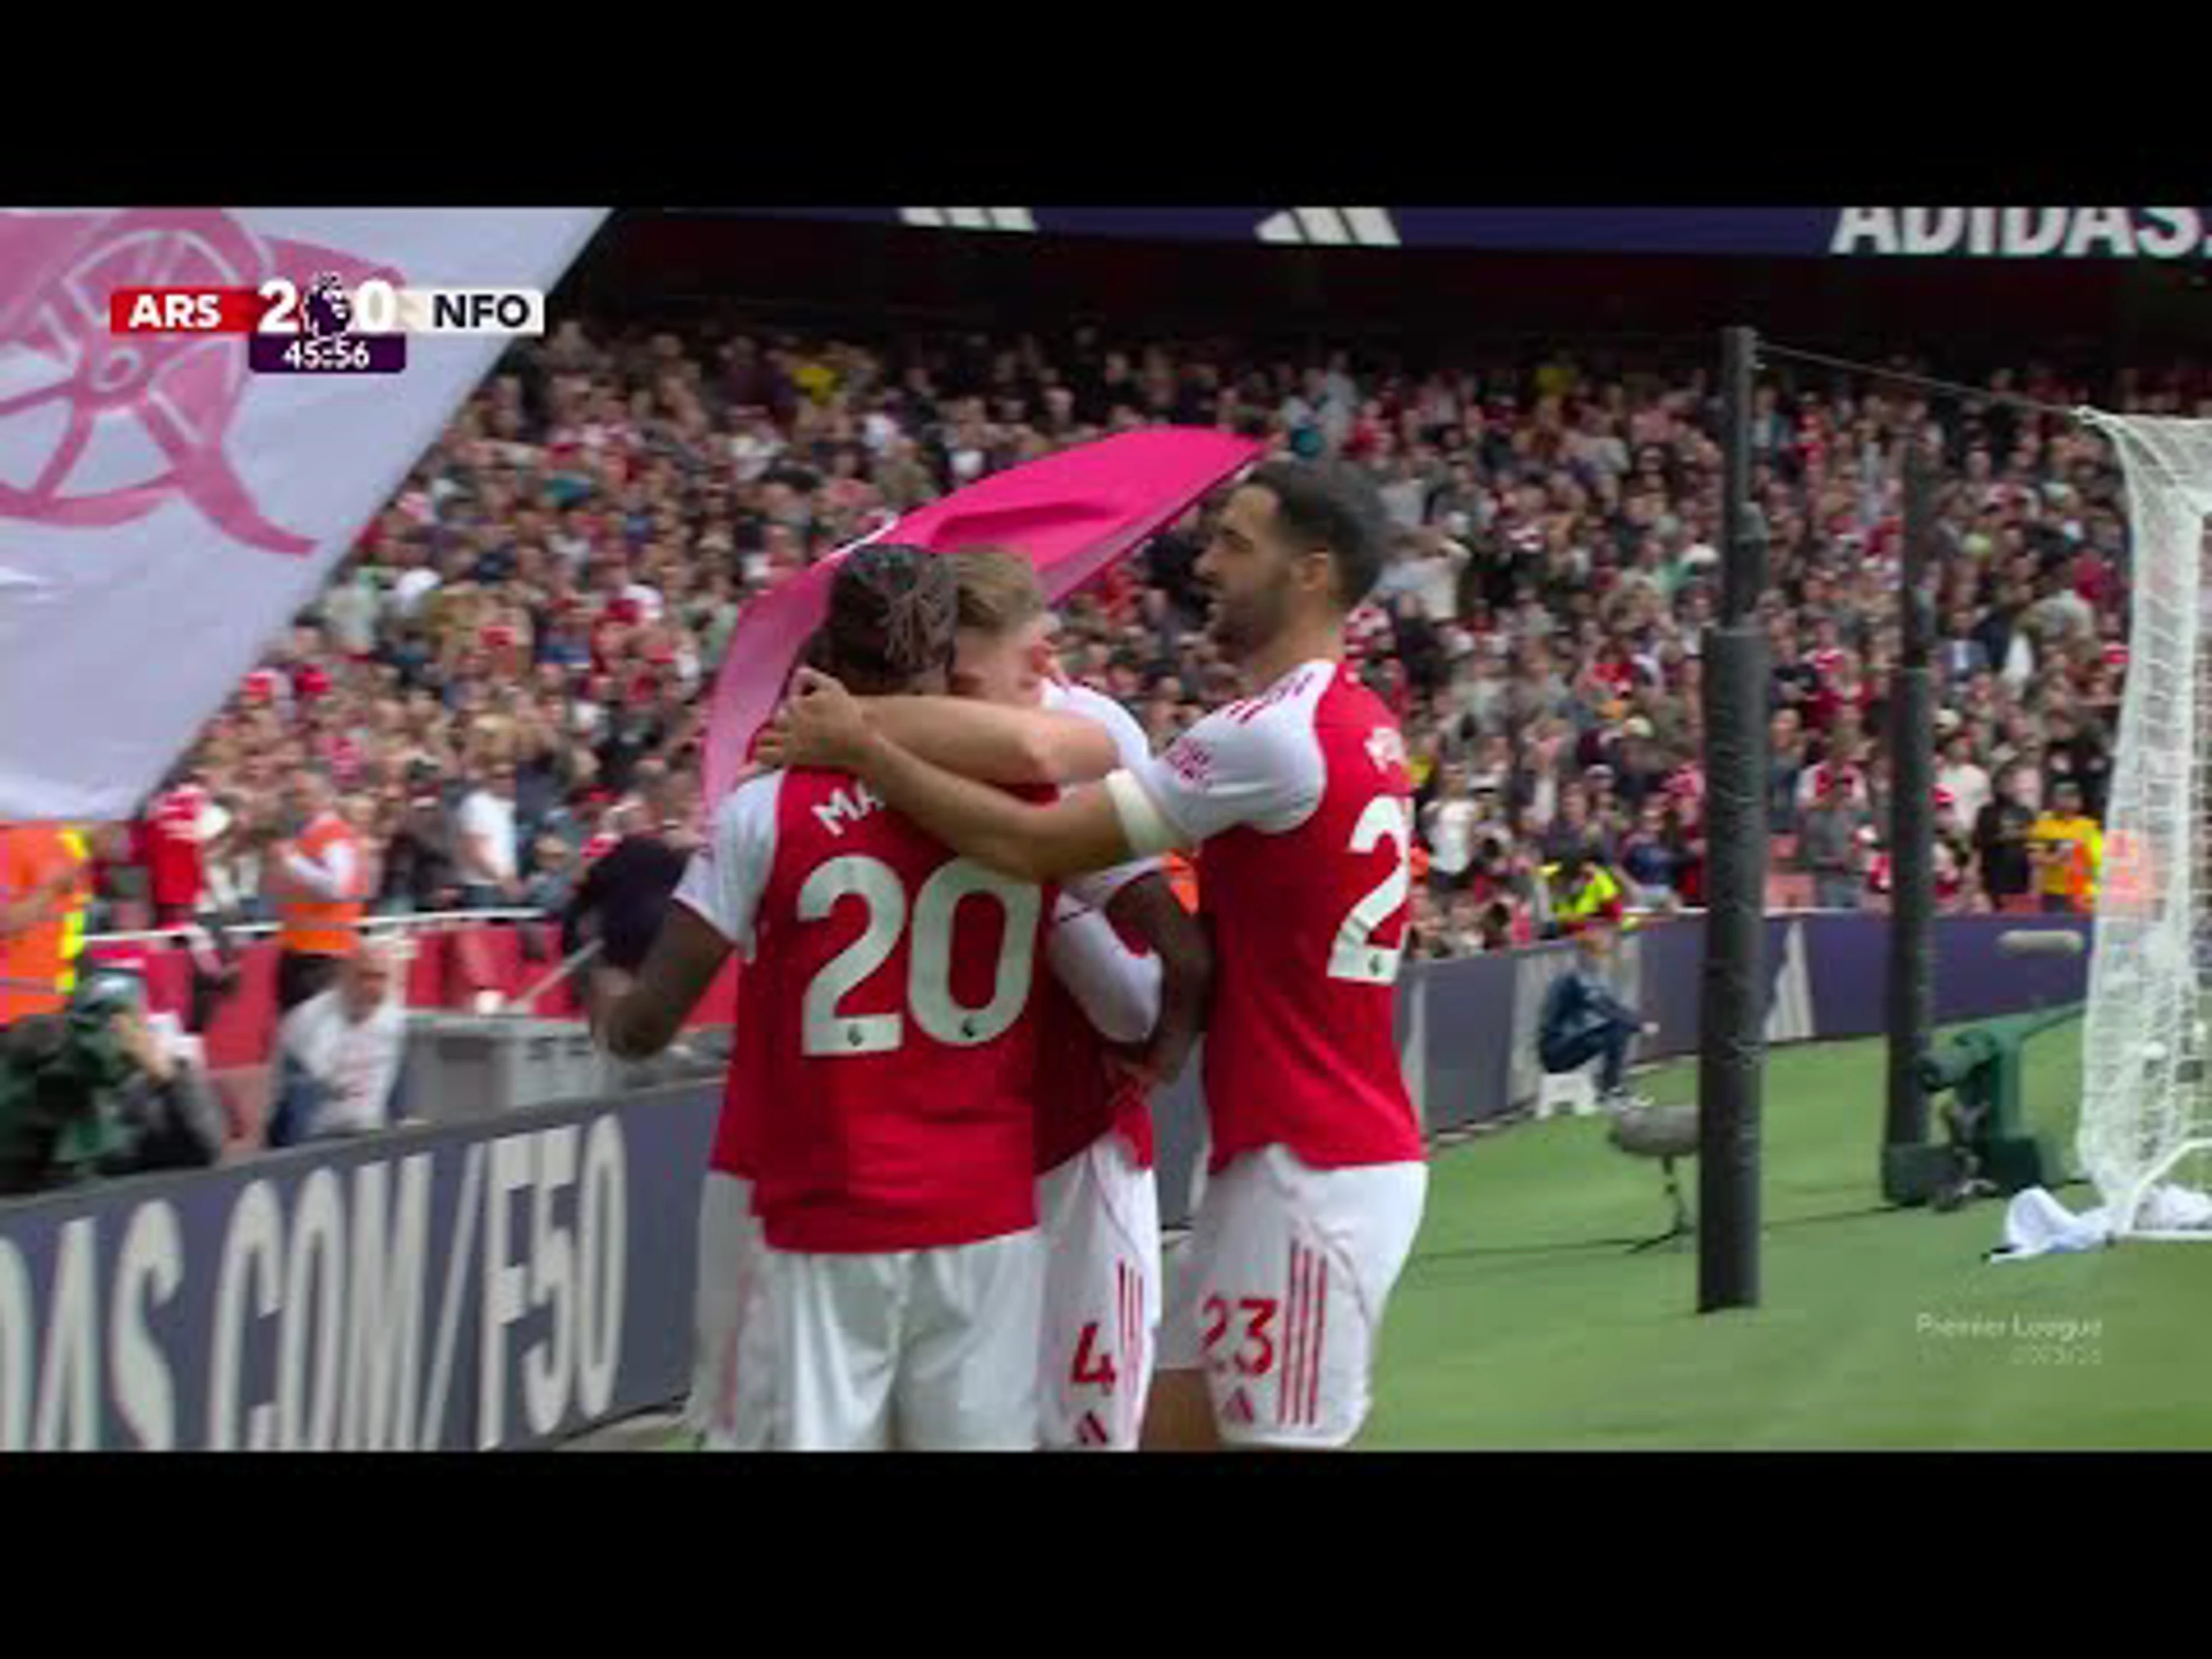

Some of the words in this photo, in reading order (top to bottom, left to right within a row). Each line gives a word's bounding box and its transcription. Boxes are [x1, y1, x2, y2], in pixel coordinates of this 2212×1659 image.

[798, 854, 1041, 1057] 20
[1327, 795, 1416, 983] 2
[1070, 1321, 1116, 1395] 4
[1201, 1296, 1279, 1376] 23
